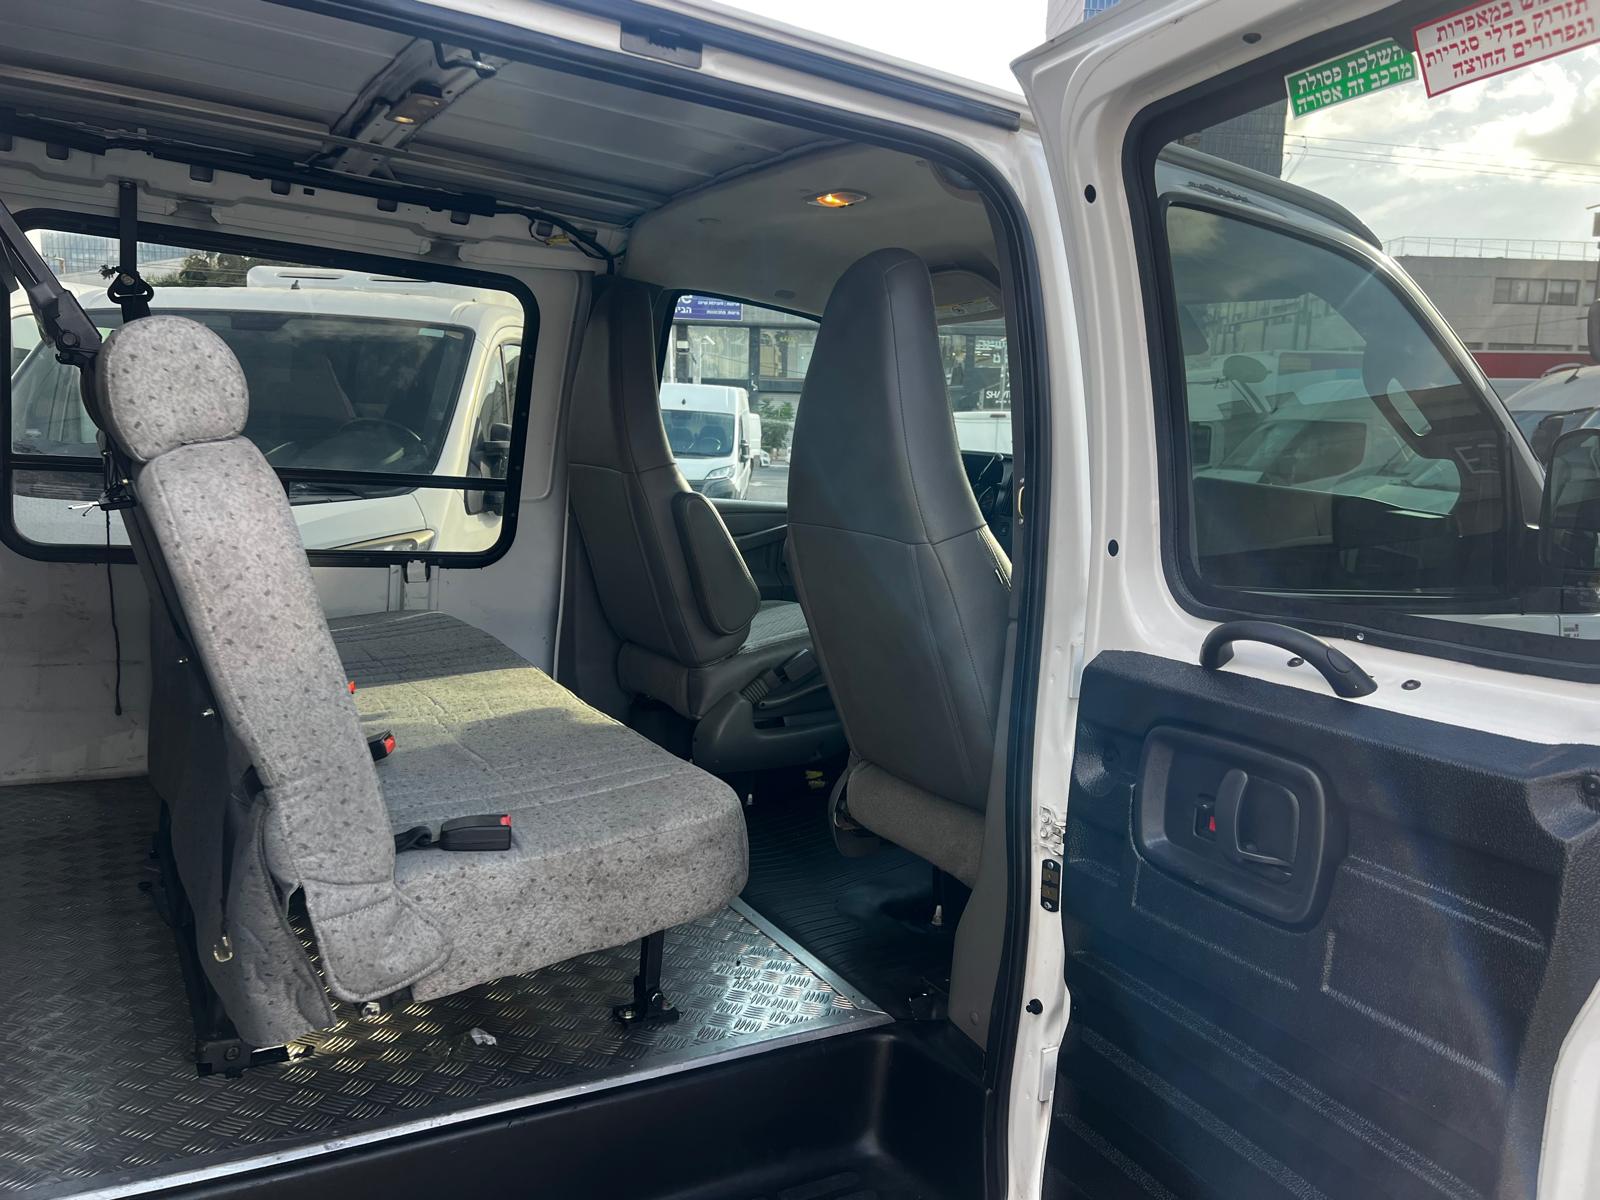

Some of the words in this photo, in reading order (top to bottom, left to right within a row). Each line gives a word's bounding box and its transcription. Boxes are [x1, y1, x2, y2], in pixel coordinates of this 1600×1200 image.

[1436, 1, 1514, 42] במאפרות
[1485, 19, 1527, 44] בדלי
[1532, 0, 1589, 33] תזרוק
[1425, 35, 1481, 68] סגריות
[1513, 17, 1596, 58] וגפרורים
[1347, 45, 1404, 77] השלכת
[1370, 62, 1413, 89] מרכב
[1452, 47, 1507, 79] החוצה
[1298, 66, 1342, 95] פסולת
[1347, 78, 1365, 97] זה
[1296, 85, 1343, 114] אסורה
